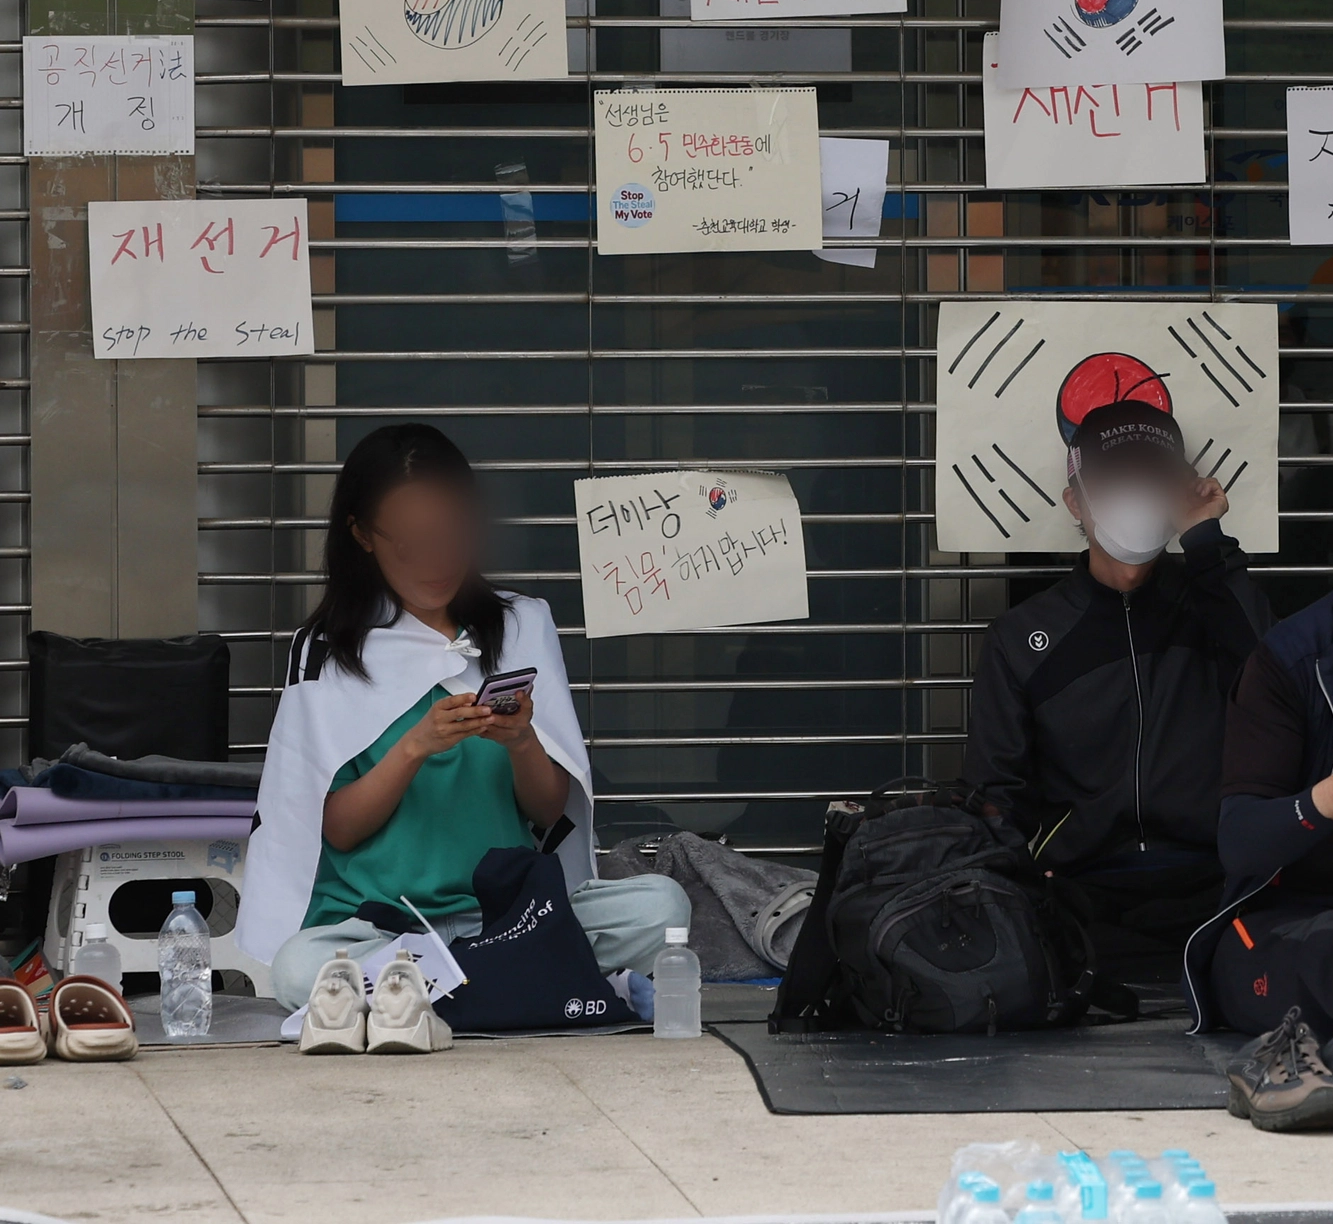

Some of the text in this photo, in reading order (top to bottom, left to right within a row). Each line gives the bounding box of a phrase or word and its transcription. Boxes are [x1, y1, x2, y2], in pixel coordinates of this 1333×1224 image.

[613, 200, 653, 209] The Steal
[620, 191, 644, 201] Stop
[615, 210, 652, 220] My Vote
[111, 216, 300, 274] 재선거
[170, 321, 207, 342] the
[1100, 424, 1175, 443] MAKE KOREA
[587, 489, 681, 538] 더이상
[538, 900, 553, 917] of
[585, 1000, 607, 1015] BD
